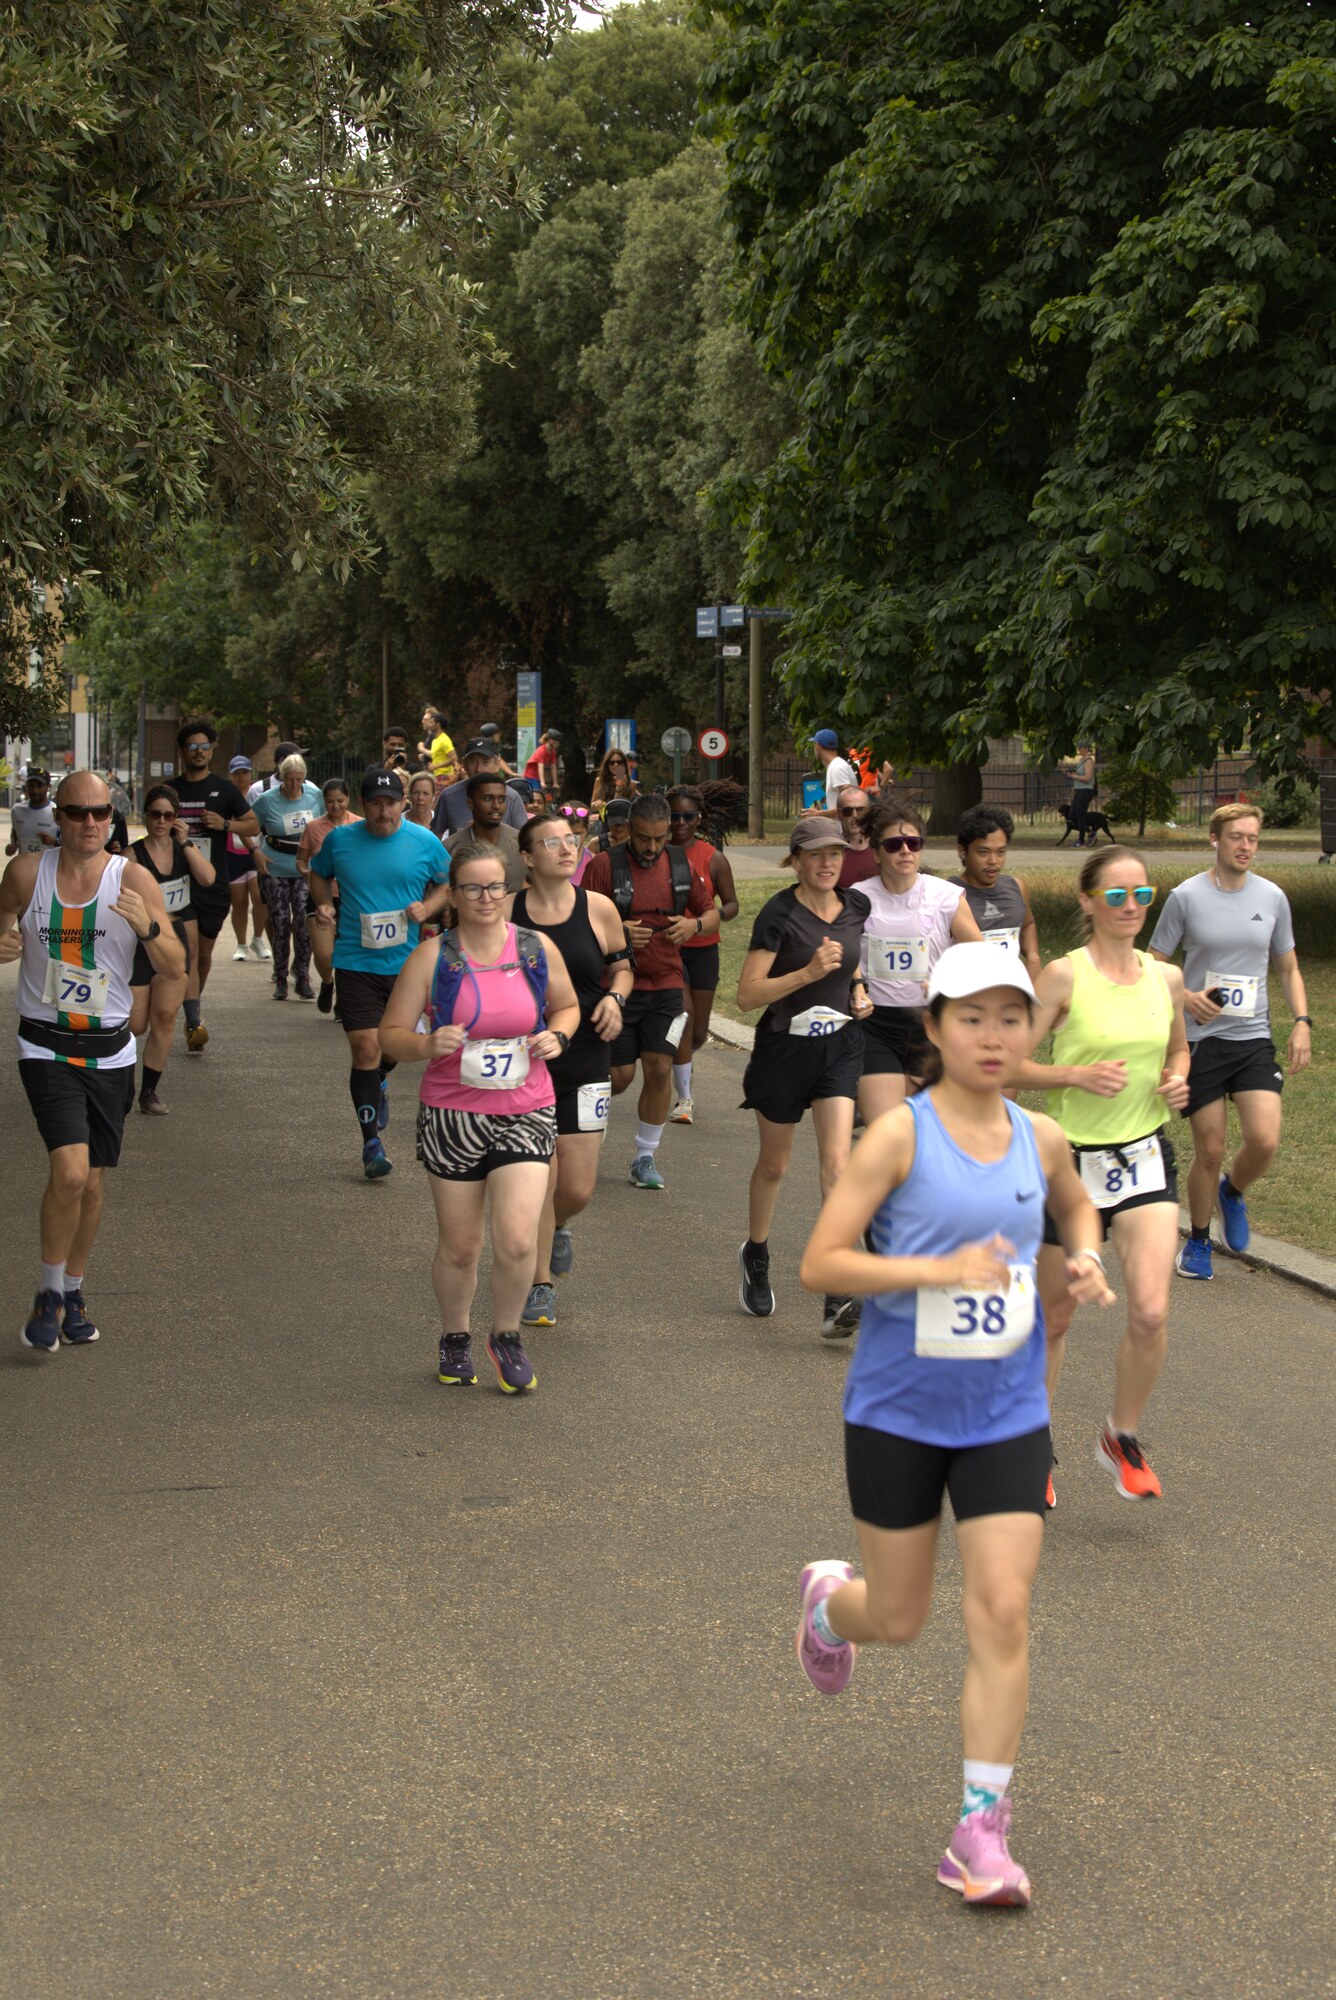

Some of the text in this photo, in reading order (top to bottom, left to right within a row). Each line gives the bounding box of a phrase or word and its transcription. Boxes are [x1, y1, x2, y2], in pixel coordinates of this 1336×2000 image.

[709, 737, 719, 750] 5
[292, 817, 306, 828] 54
[166, 888, 183, 904] 77
[38, 927, 106, 937] MORNINGTON
[38, 935, 82, 944] CHASERS
[372, 923, 396, 940] 70
[885, 951, 913, 970] 19
[60, 978, 92, 1003] 79
[808, 1021, 835, 1037] 80
[480, 1053, 512, 1077] 37
[1105, 1161, 1138, 1192] 81
[951, 1295, 1006, 1335] 38
